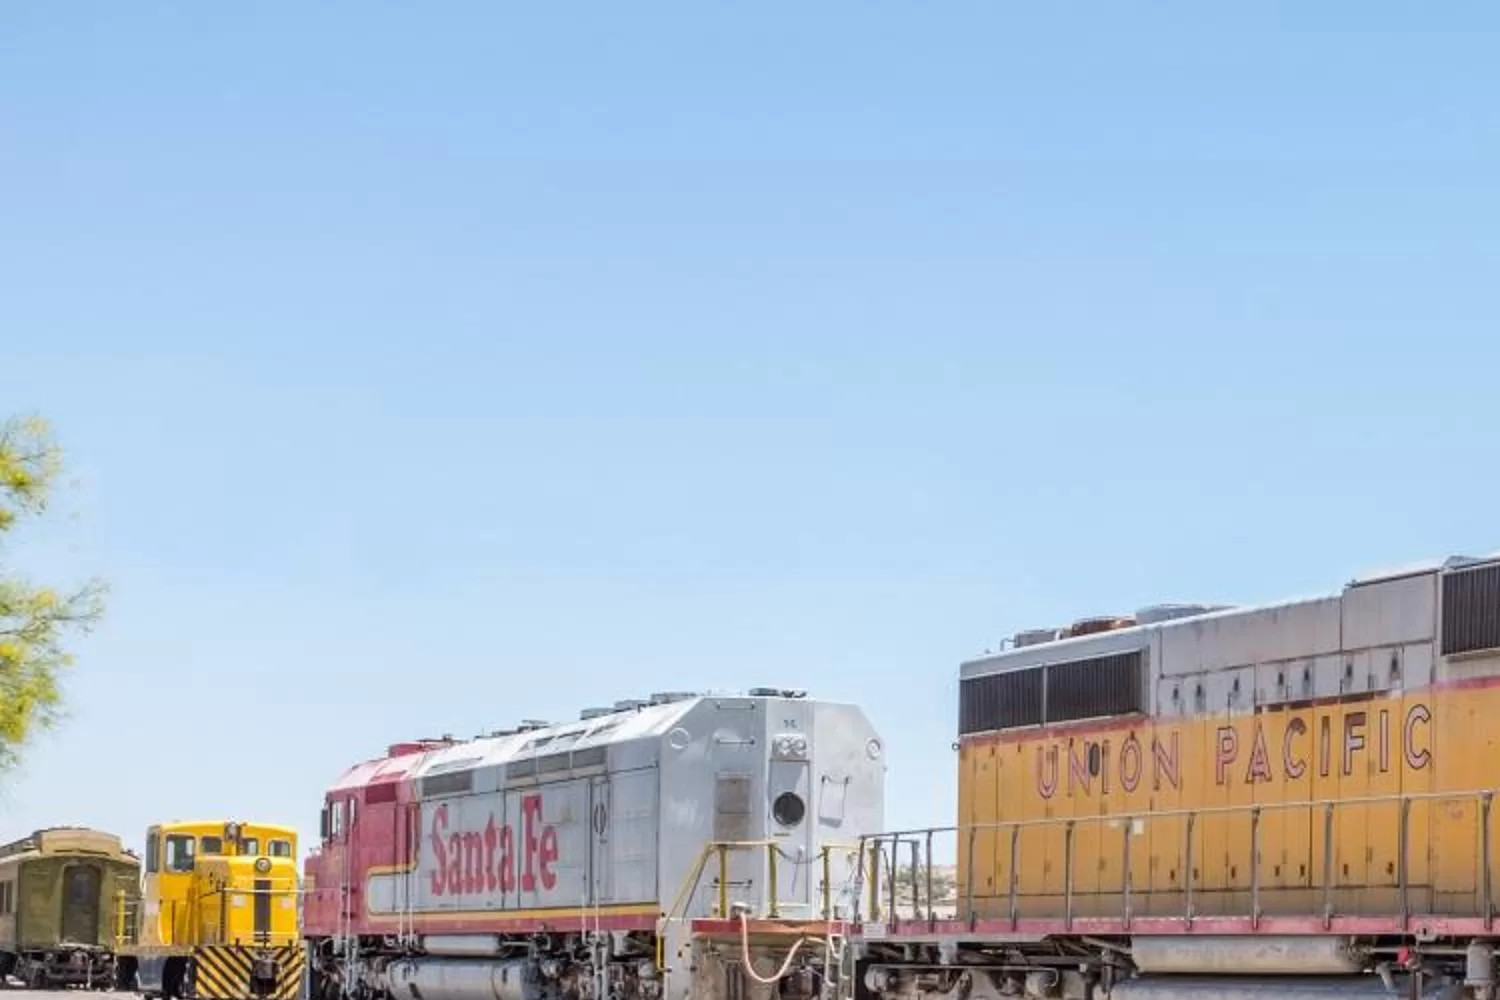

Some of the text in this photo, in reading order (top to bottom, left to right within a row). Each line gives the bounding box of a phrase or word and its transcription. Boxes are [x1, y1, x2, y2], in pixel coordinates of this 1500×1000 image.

[1037, 703, 1432, 800] UNION PACIFIC
[430, 792, 559, 896] Santa Fe
